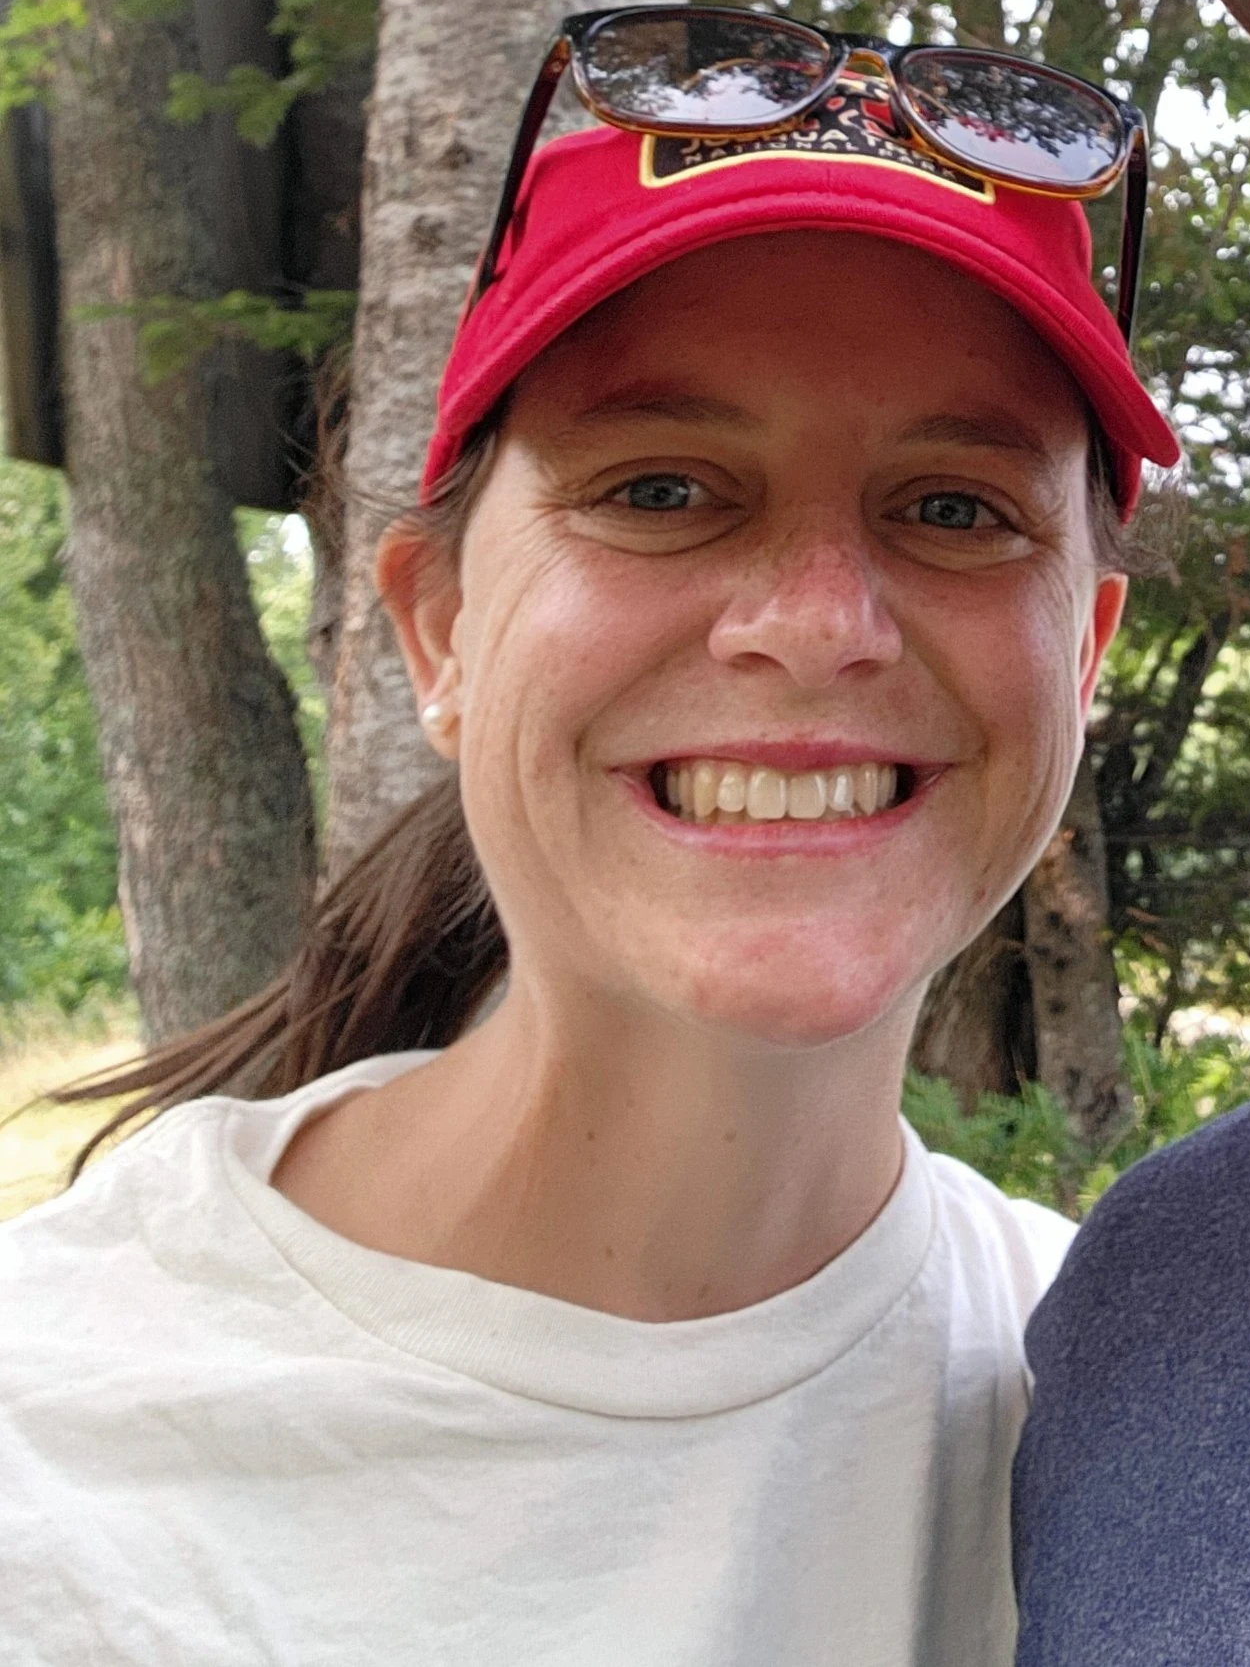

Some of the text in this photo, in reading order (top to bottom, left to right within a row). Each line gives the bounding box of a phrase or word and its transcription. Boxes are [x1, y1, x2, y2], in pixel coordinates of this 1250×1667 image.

[680, 129, 934, 161] JUA TR
[684, 139, 957, 180] NATIONAL PARK
